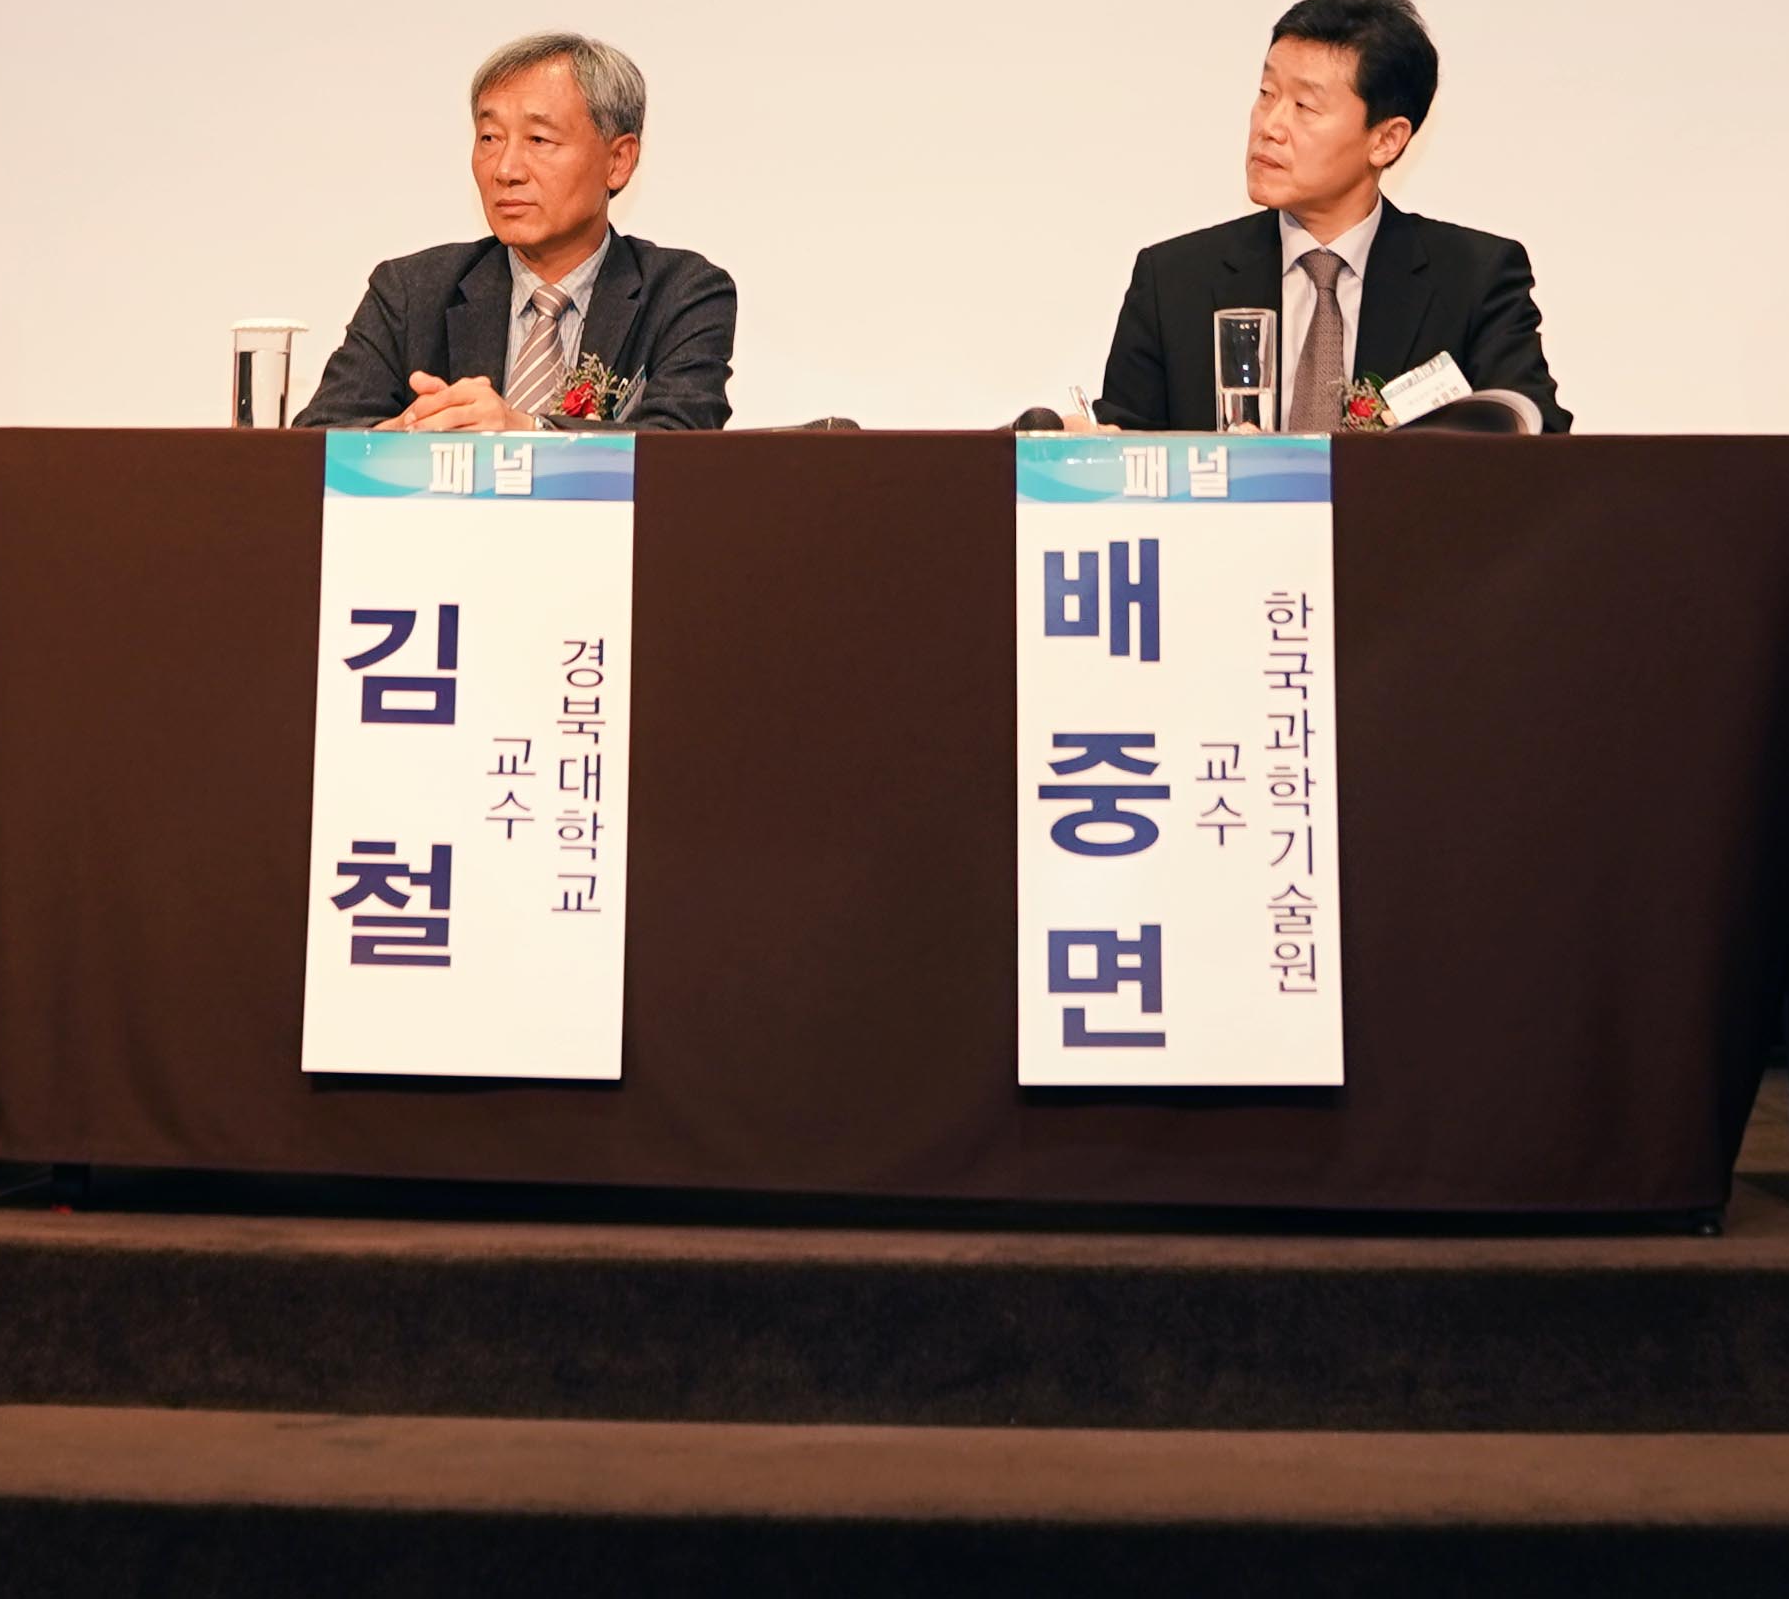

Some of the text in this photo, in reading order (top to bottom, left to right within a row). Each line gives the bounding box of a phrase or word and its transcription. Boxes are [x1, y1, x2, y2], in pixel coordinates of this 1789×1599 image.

[429, 442, 535, 496] 패널
[1122, 445, 1230, 500] 패널
[484, 737, 537, 841] 교수
[551, 637, 607, 914] 경북대학교
[1195, 742, 1248, 847] 교수
[1263, 591, 1319, 995] 한국과학기술원
